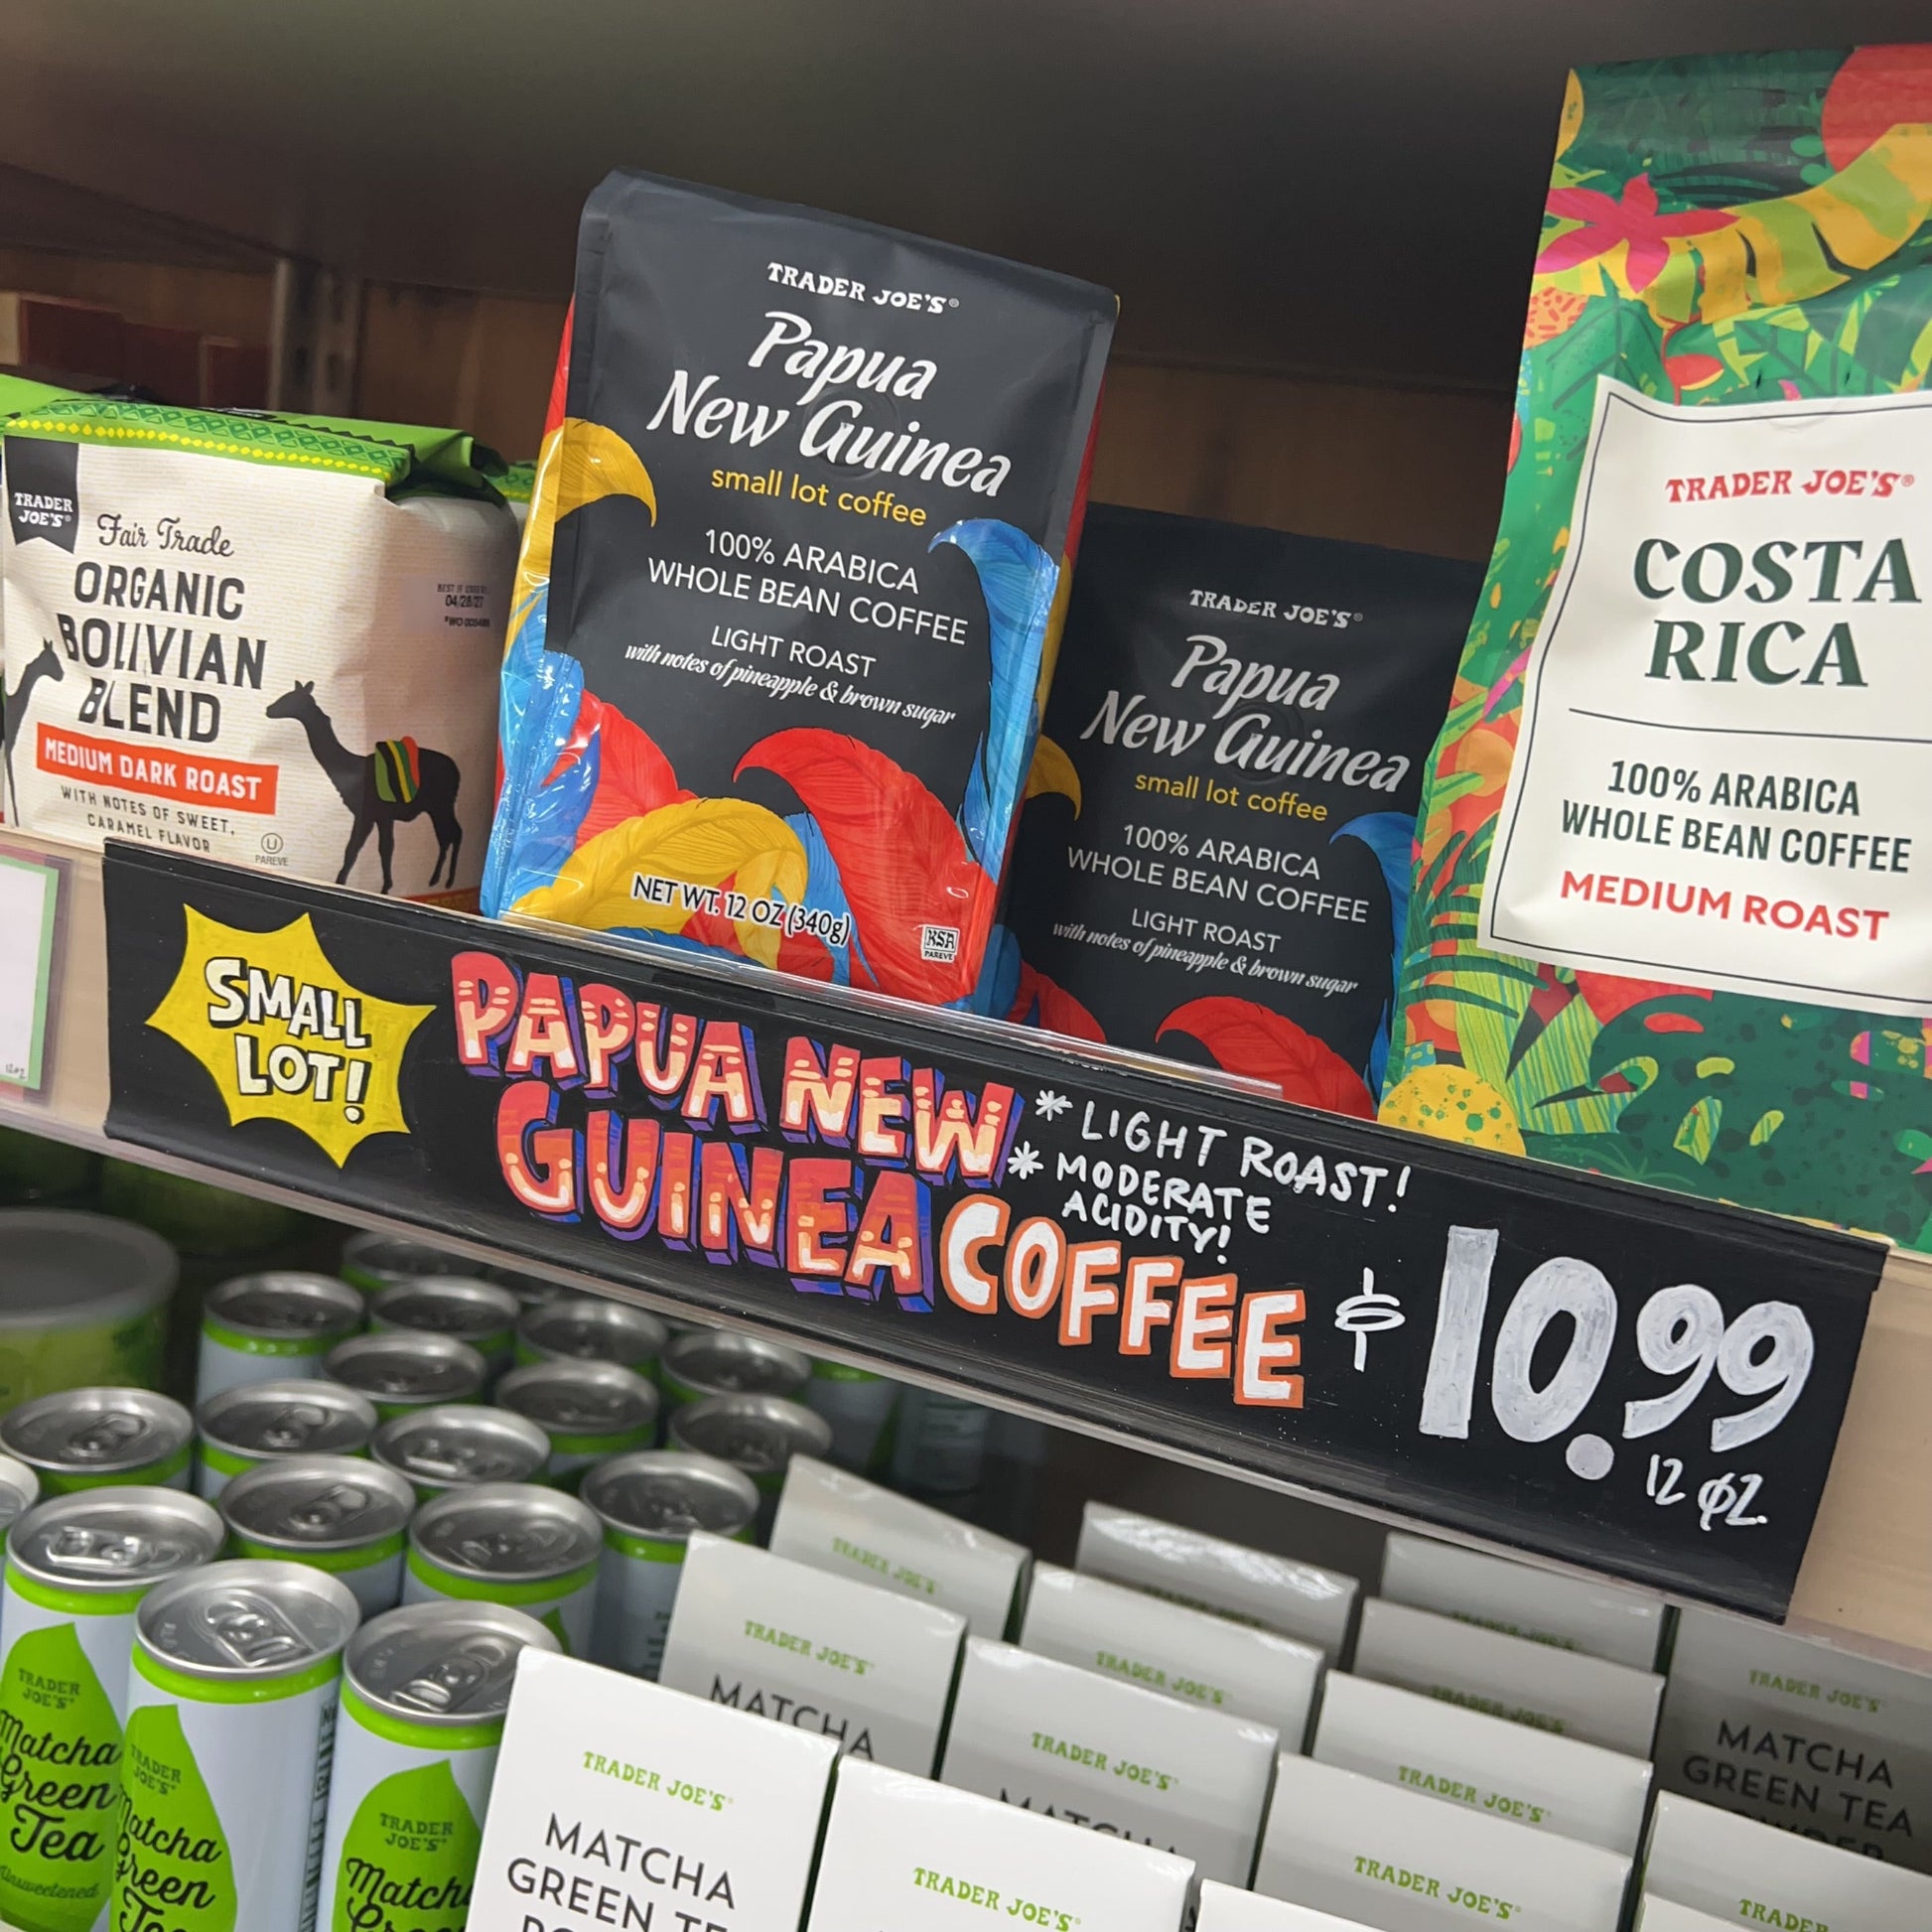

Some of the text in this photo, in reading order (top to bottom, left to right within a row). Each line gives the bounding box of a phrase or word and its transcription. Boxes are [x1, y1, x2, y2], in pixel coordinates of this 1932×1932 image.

[767, 262, 866, 302] TRADER
[748, 311, 938, 406] Papua
[646, 369, 1012, 497] New Guinea
[15, 492, 73, 513] TRADER
[711, 466, 927, 527] small lot coffee
[1666, 471, 1792, 503] TRADER
[97, 514, 234, 557] Fair Trade
[704, 529, 918, 595] 100% ARABICA
[74, 561, 244, 621] ORGANIC
[648, 558, 968, 645] WHOLE BEAN COFFEE
[1633, 538, 1922, 604] COSTA
[1189, 589, 1278, 619] TRADER
[57, 613, 267, 690] BOLIVIAN
[711, 625, 876, 678] LIGHT ROAST
[1171, 633, 1339, 721] Papua
[1644, 619, 1868, 687] RICA
[78, 677, 220, 743] BLEND
[624, 642, 956, 727] with notes of pineapple & brown sugar
[45, 737, 262, 801] MEDIUM DARK ROAST
[1080, 690, 1411, 793] New Guinea
[62, 785, 235, 835] WITH NOTES OF SWEET,
[1135, 772, 1327, 822] small lot coffee
[1607, 760, 1861, 816] 100% ARABICA
[87, 813, 210, 854] CARAMEL FLAVOR
[255, 855, 289, 867] PAREVE
[1123, 824, 1320, 881] 100% ARABICA
[1562, 799, 1911, 874] WHOLE BEAN COFFEE
[632, 874, 852, 947] NET WT. 12 OZ (340g)
[1067, 847, 1369, 923] WHOLE BEAN COFFEE
[1560, 869, 1890, 941] MEDIUM ROAST
[924, 950, 953, 961] PAREVE
[1052, 920, 1358, 998] with notes of pineapple & brown sugar
[1131, 908, 1281, 953] LIGHT ROAST
[204, 957, 370, 1049] SMALL
[234, 1034, 370, 1124] LOT!
[451, 951, 1025, 1188] PAPUA NEW
[1082, 1101, 1411, 1213] LIGHT ROAST!
[496, 1081, 934, 1313] GUINEA
[1057, 1153, 1271, 1234] MODERATE
[1061, 1190, 1232, 1264] ACIDITY!
[939, 1193, 1307, 1410] COFFEE
[1646, 1453, 1686, 1506] 12
[744, 1620, 811, 1657] TRADER
[1096, 1650, 1166, 1687] TRADER
[18, 1668, 80, 1697] TRADER
[1748, 1669, 1821, 1699] TRADER
[0, 1710, 122, 1766] Matcha
[710, 1673, 875, 1761] MATCHA
[0, 1750, 117, 1803] Green
[583, 1751, 660, 1791] TRADER
[1032, 1732, 1108, 1771] TRADER
[1717, 1720, 1893, 1789] MATCHA
[1398, 1765, 1476, 1805] TRADER
[1682, 1755, 1820, 1813] GREEN
[1839, 1791, 1913, 1838] TEA
[10, 1803, 105, 1862] Tea
[380, 1812, 454, 1836] TRADER
[546, 1812, 735, 1909] MATCHA
[913, 1866, 1000, 1911] TRADER
[1353, 1856, 1441, 1897] TRADER
[507, 1858, 654, 1932] GREEN
